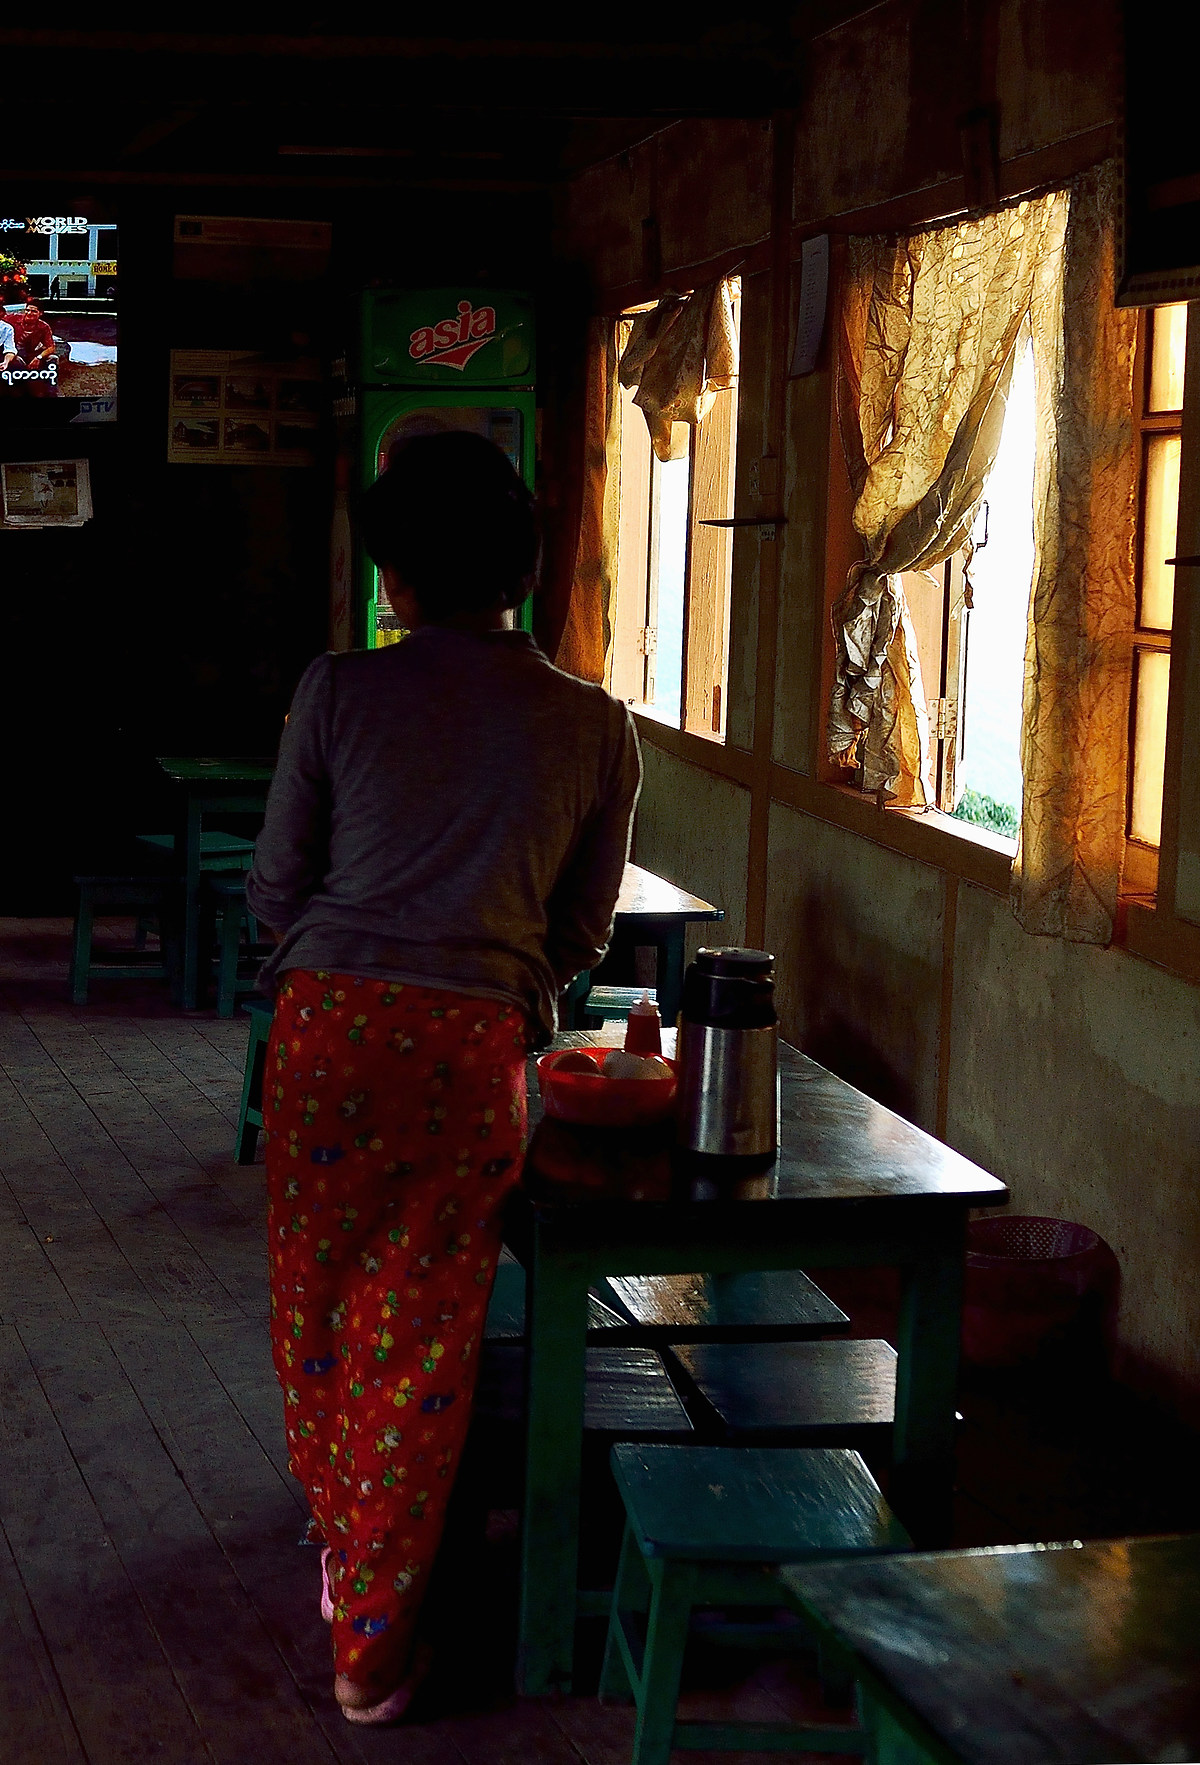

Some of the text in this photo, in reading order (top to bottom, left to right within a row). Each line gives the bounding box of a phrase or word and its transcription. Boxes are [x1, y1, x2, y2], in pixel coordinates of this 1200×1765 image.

[25, 217, 88, 225] WORLD
[407, 300, 497, 359] asia
[79, 402, 114, 414] DTV
